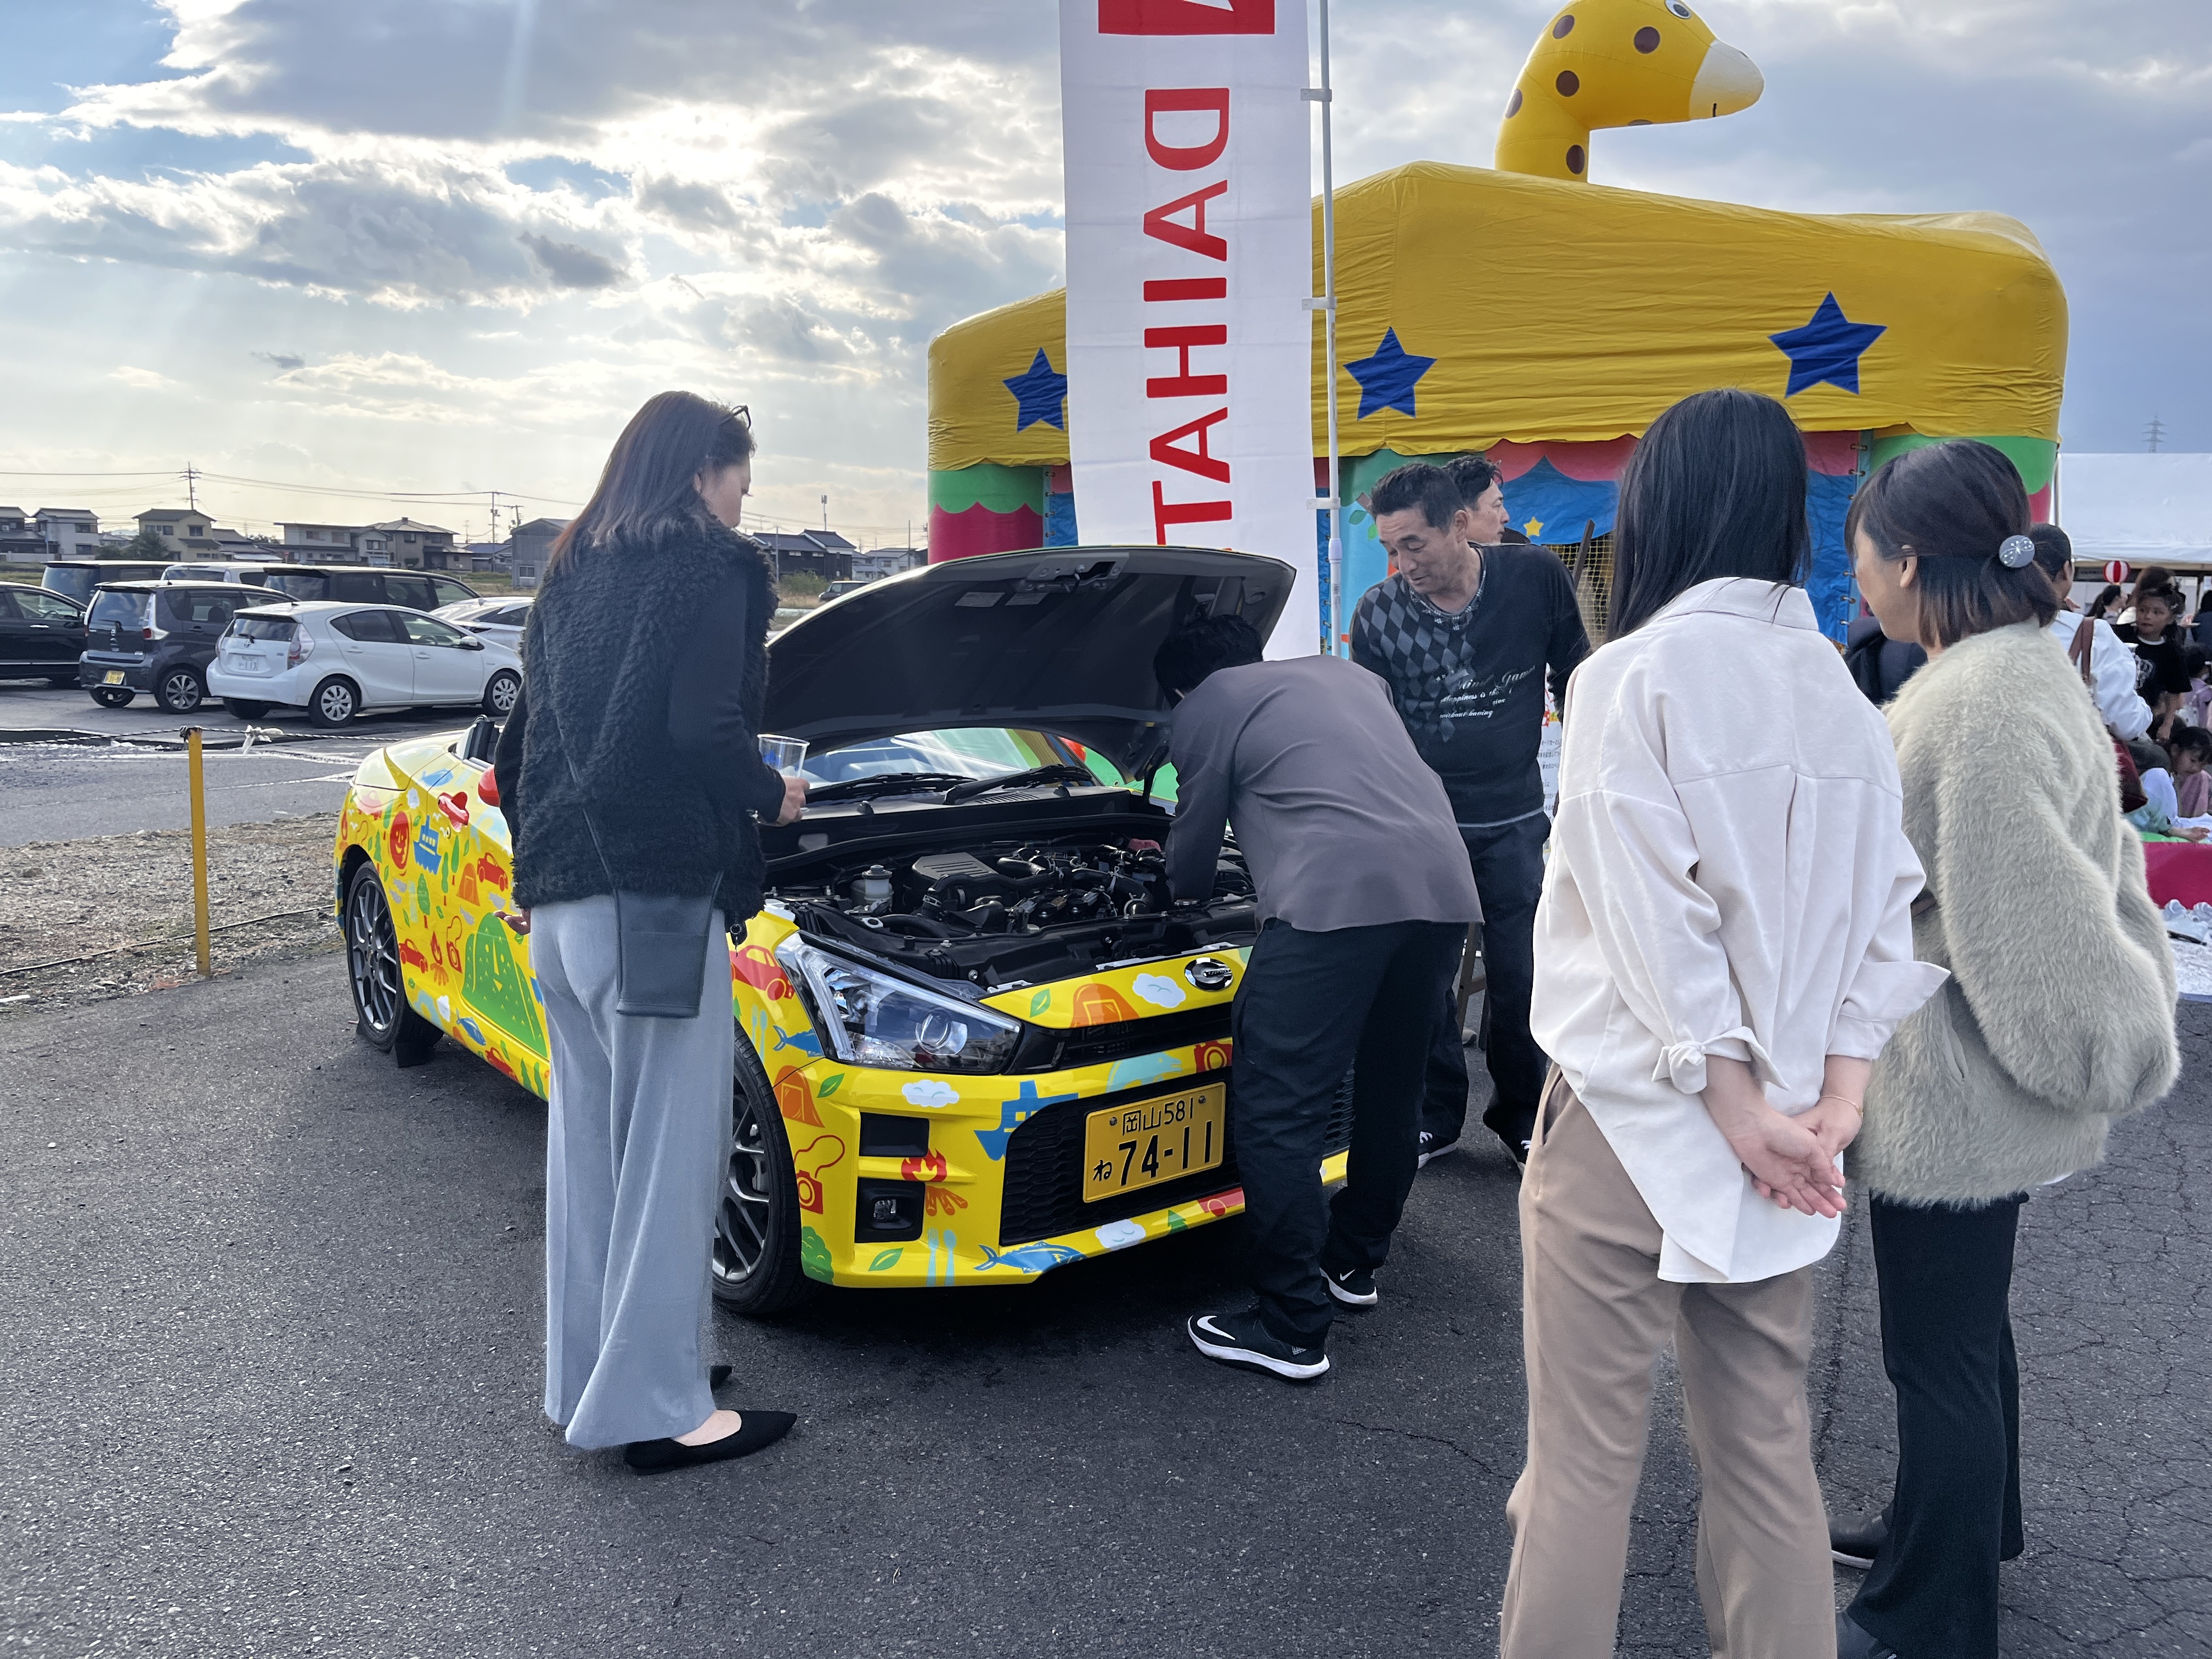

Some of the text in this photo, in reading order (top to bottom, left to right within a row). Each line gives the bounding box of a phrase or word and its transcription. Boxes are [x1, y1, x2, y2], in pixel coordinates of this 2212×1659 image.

[1122, 1097, 1194, 1136] 岡山581
[1093, 1120, 1212, 1187] ね 74-11
